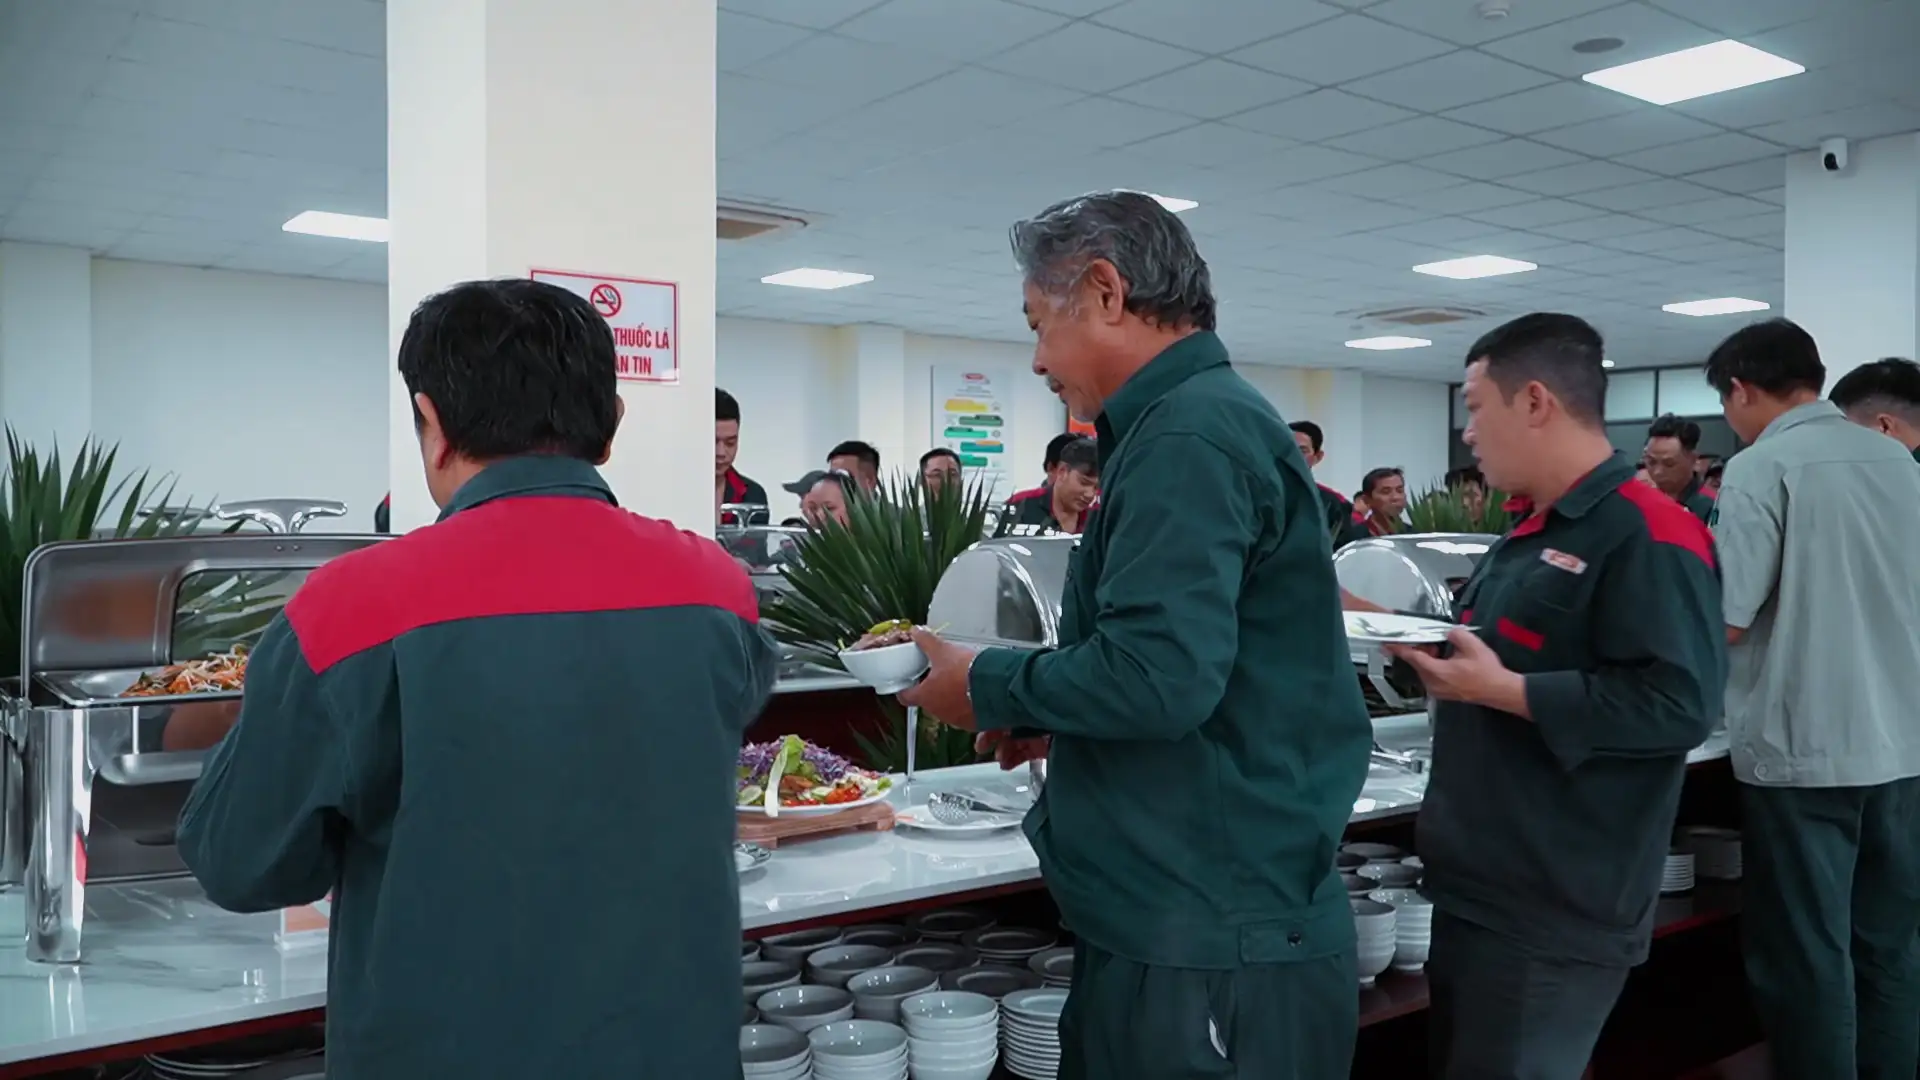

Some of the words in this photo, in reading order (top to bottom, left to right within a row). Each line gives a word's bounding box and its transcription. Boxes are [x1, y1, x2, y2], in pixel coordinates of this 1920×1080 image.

[613, 322, 652, 348] THUỐC
[655, 327, 670, 349] LÁ
[632, 355, 652, 375] TIN
